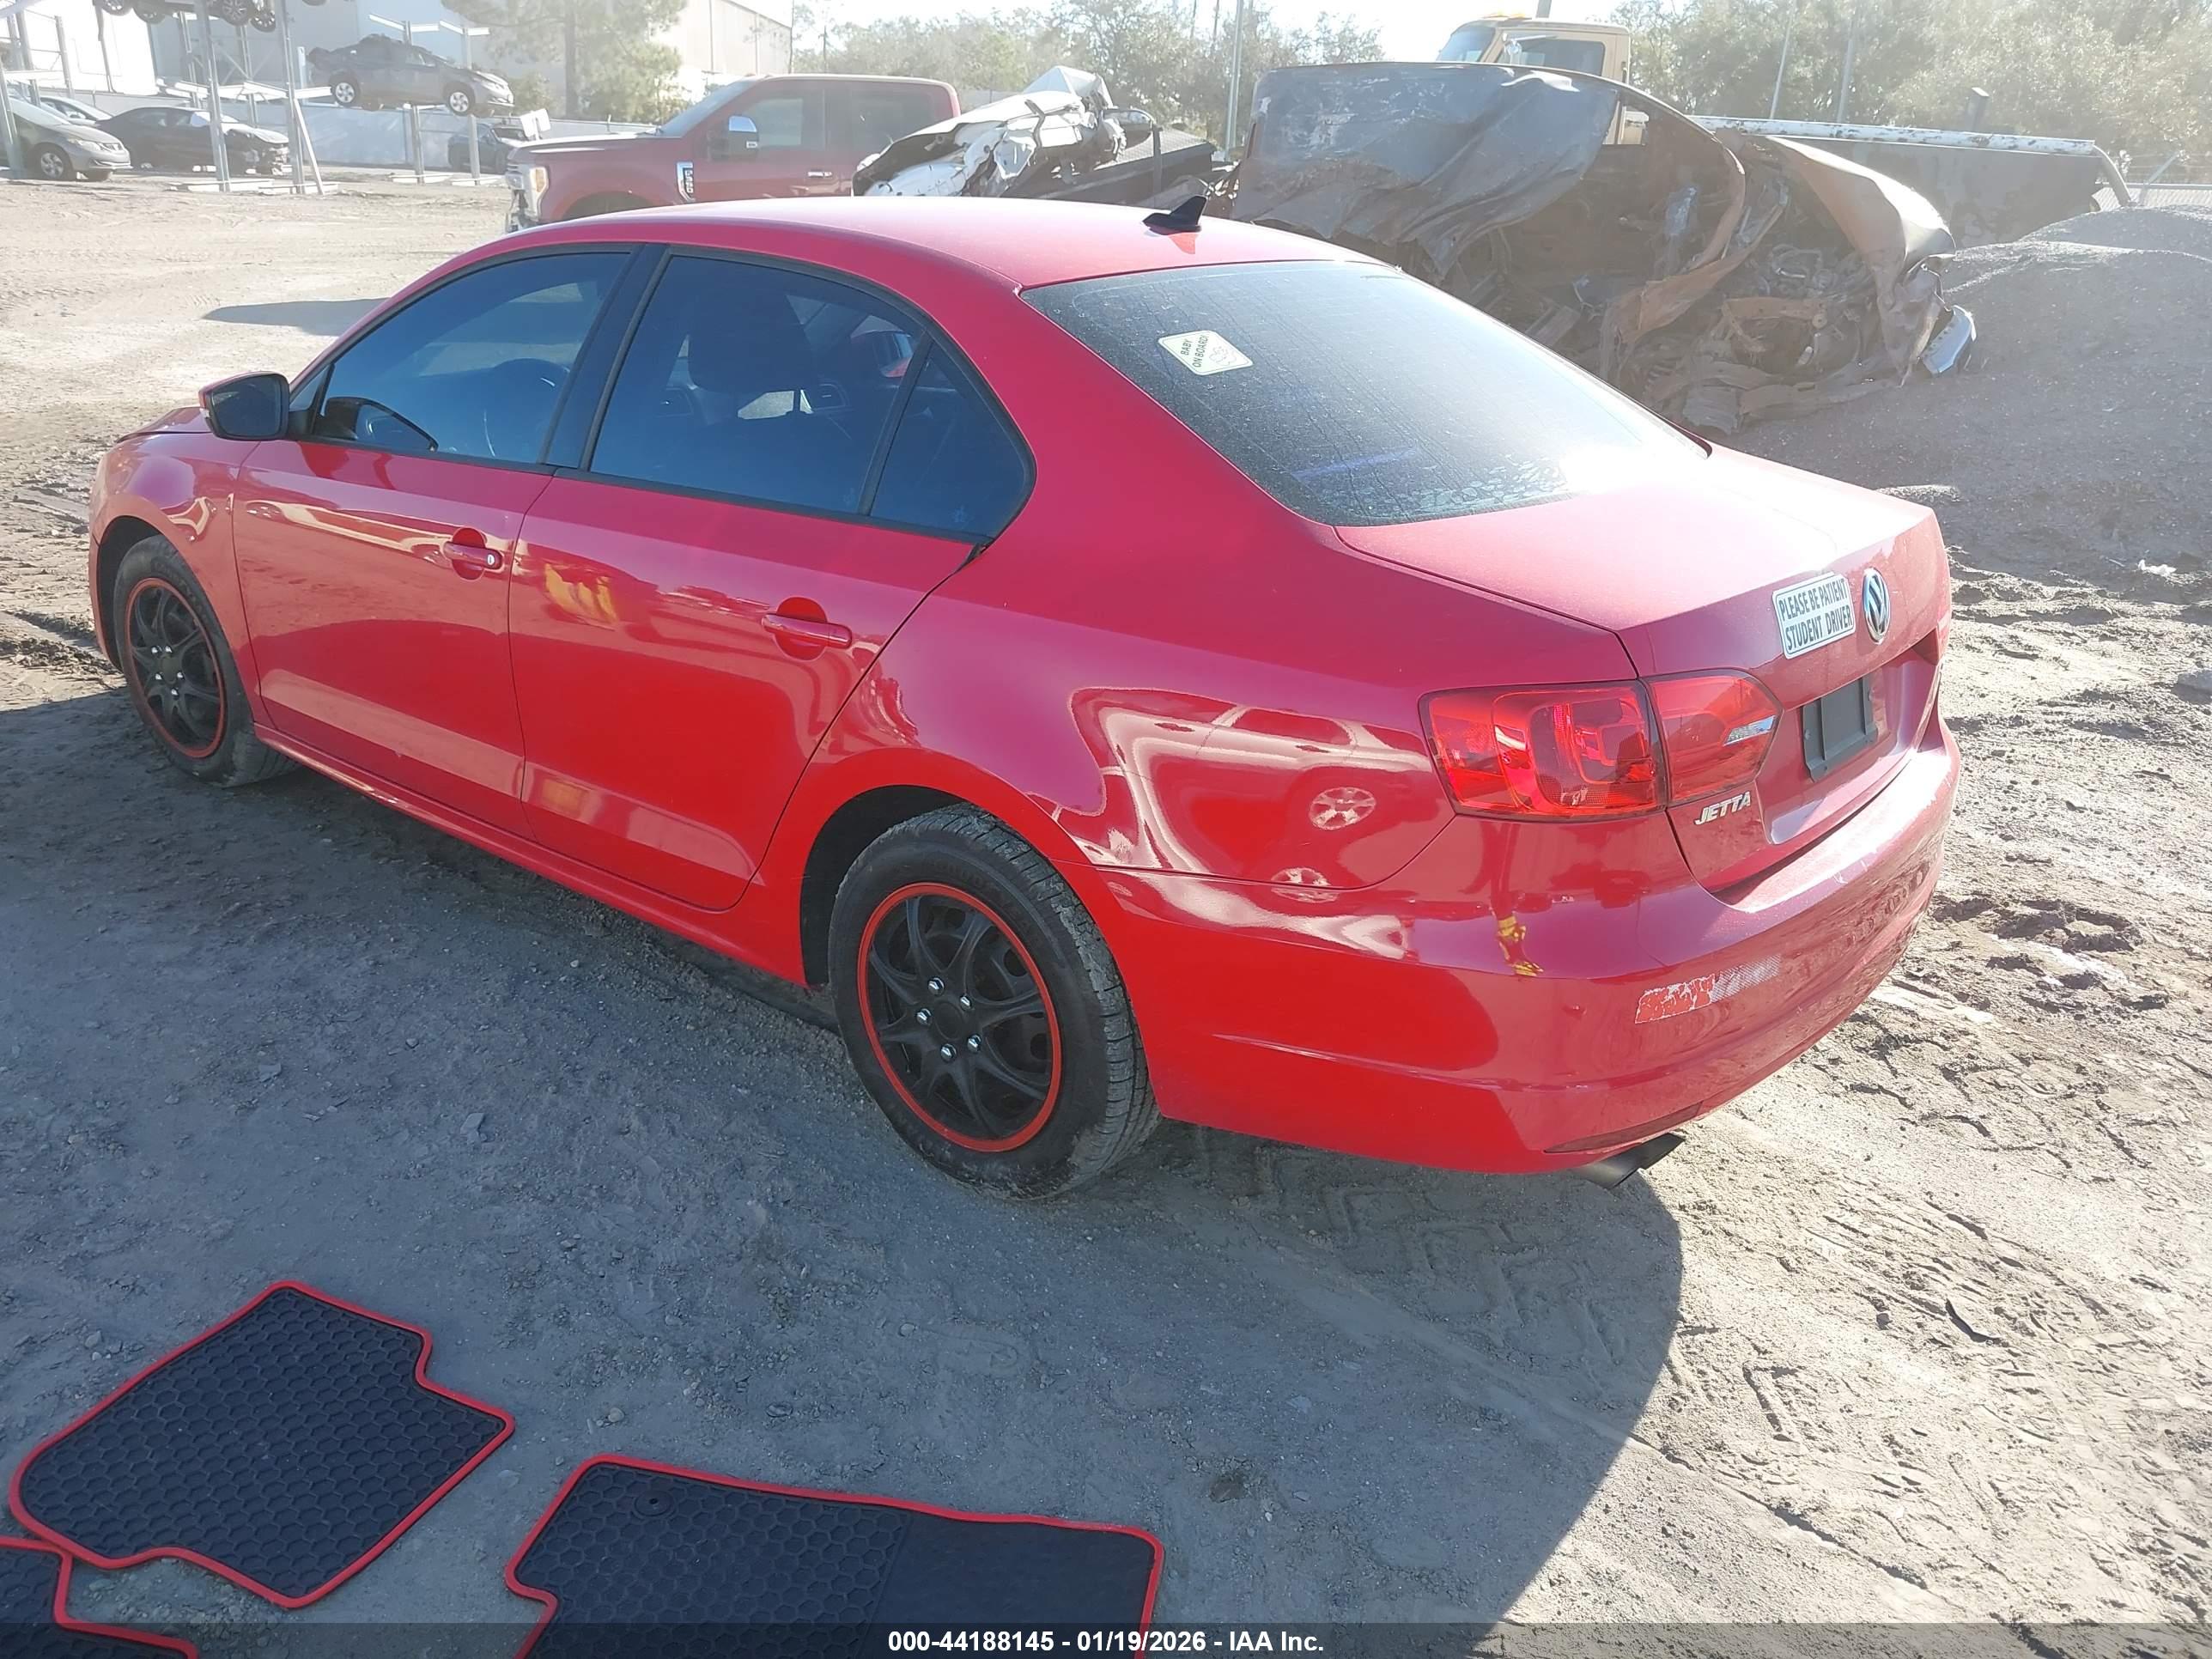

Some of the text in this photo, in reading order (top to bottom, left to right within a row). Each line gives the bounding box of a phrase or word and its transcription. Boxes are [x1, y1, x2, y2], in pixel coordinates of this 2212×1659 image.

[1181, 338, 1193, 356] BABY
[1192, 356, 1202, 368] ON
[1778, 578, 1848, 622] PLEASE BE PATIENT
[1785, 605, 1853, 651] STUDENT DRIVER
[1694, 791, 1751, 825] JETTA
